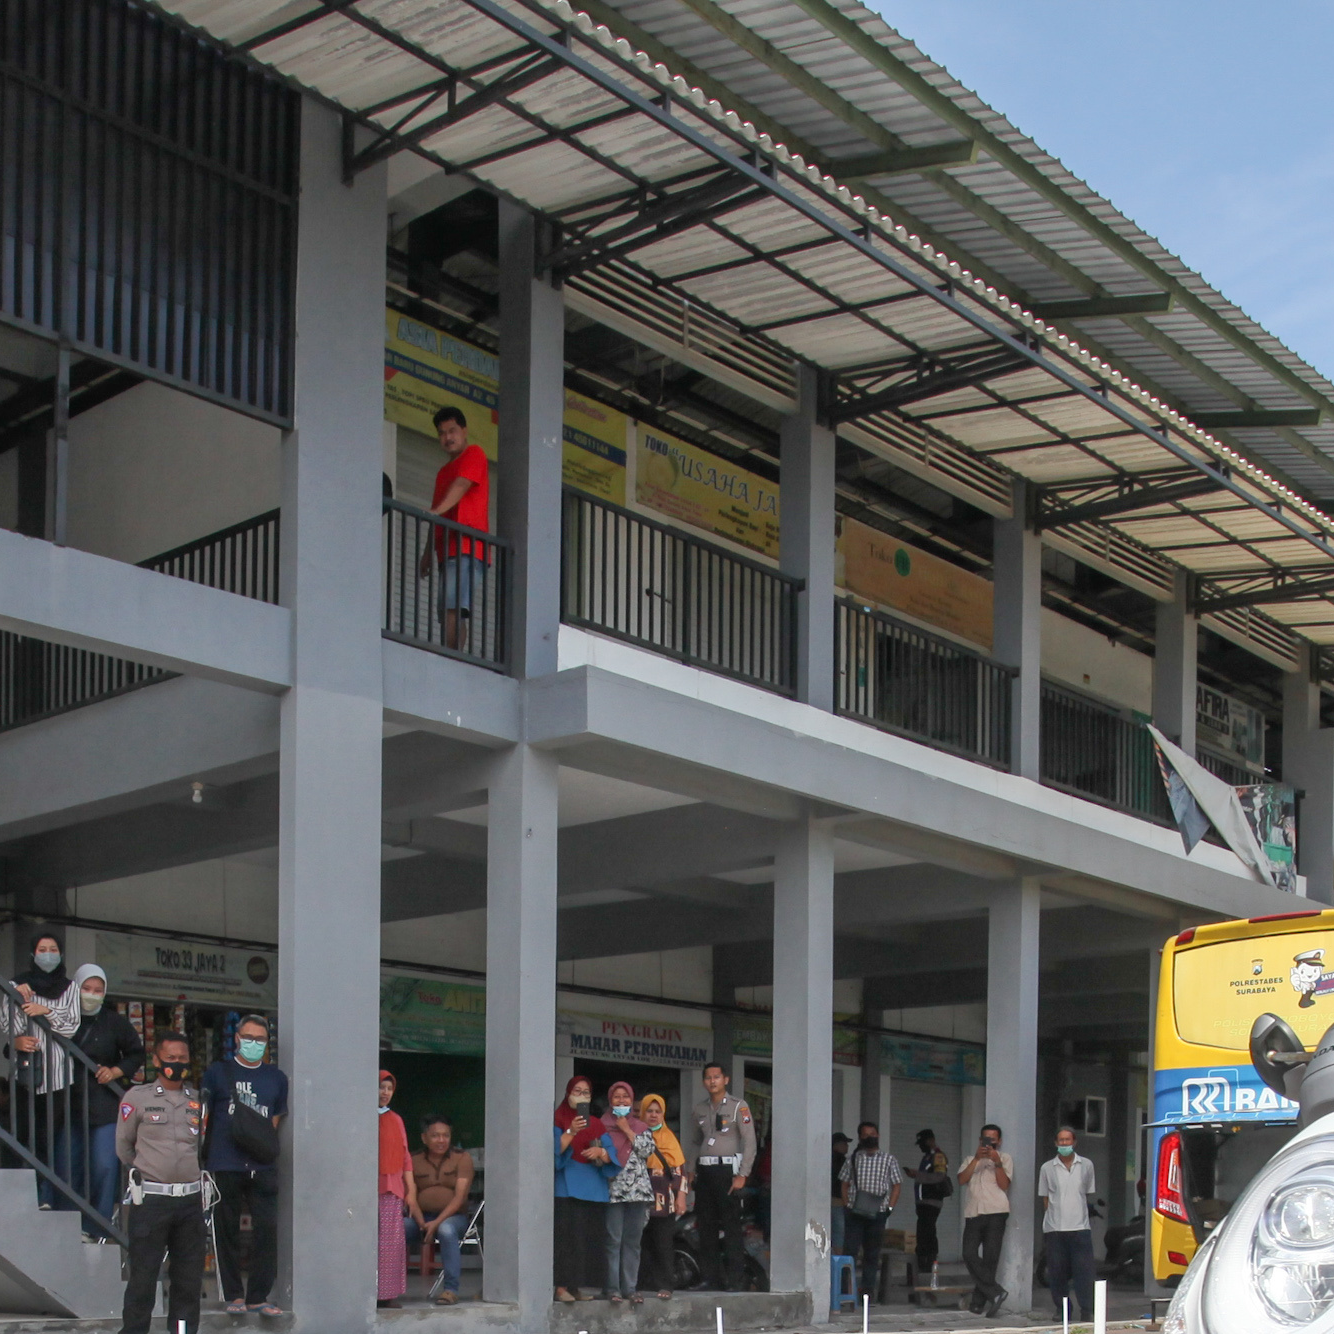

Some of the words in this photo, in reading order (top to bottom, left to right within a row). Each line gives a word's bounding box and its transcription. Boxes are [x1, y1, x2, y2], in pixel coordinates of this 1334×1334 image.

[645, 435, 668, 457] TOKO
[753, 490, 777, 516] JA
[155, 947, 180, 970] TOKO
[181, 949, 193, 971] 33
[194, 952, 220, 974] JAYA
[219, 954, 227, 974] 2
[1229, 977, 1284, 988] POLRESTABES
[1236, 986, 1276, 996] SURABAYA
[602, 1021, 683, 1042] PENGRAJIN
[571, 1033, 621, 1054] MAHAR
[623, 1040, 708, 1062] PERNIKAHAN
[1235, 1087, 1300, 1112] BAN
